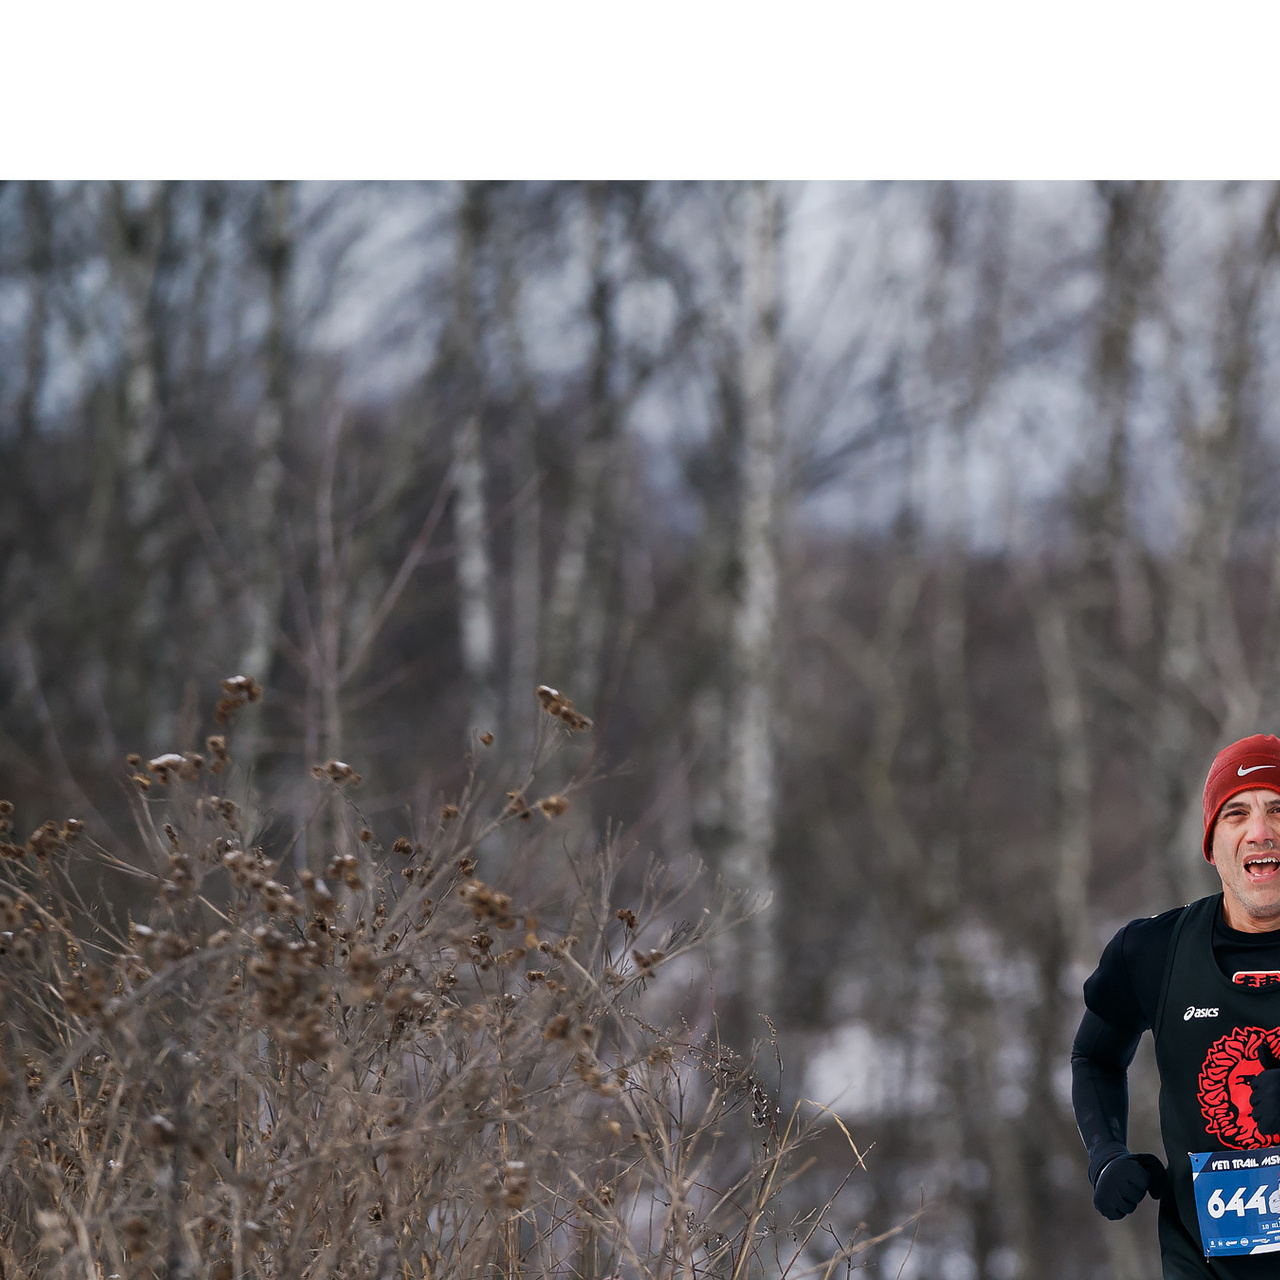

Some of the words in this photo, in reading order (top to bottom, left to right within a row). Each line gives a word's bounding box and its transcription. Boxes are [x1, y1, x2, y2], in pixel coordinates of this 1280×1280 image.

[1211, 1160, 1230, 1170] YETI
[1232, 1158, 1259, 1169] TRAIL
[1207, 1184, 1269, 1219] 644
